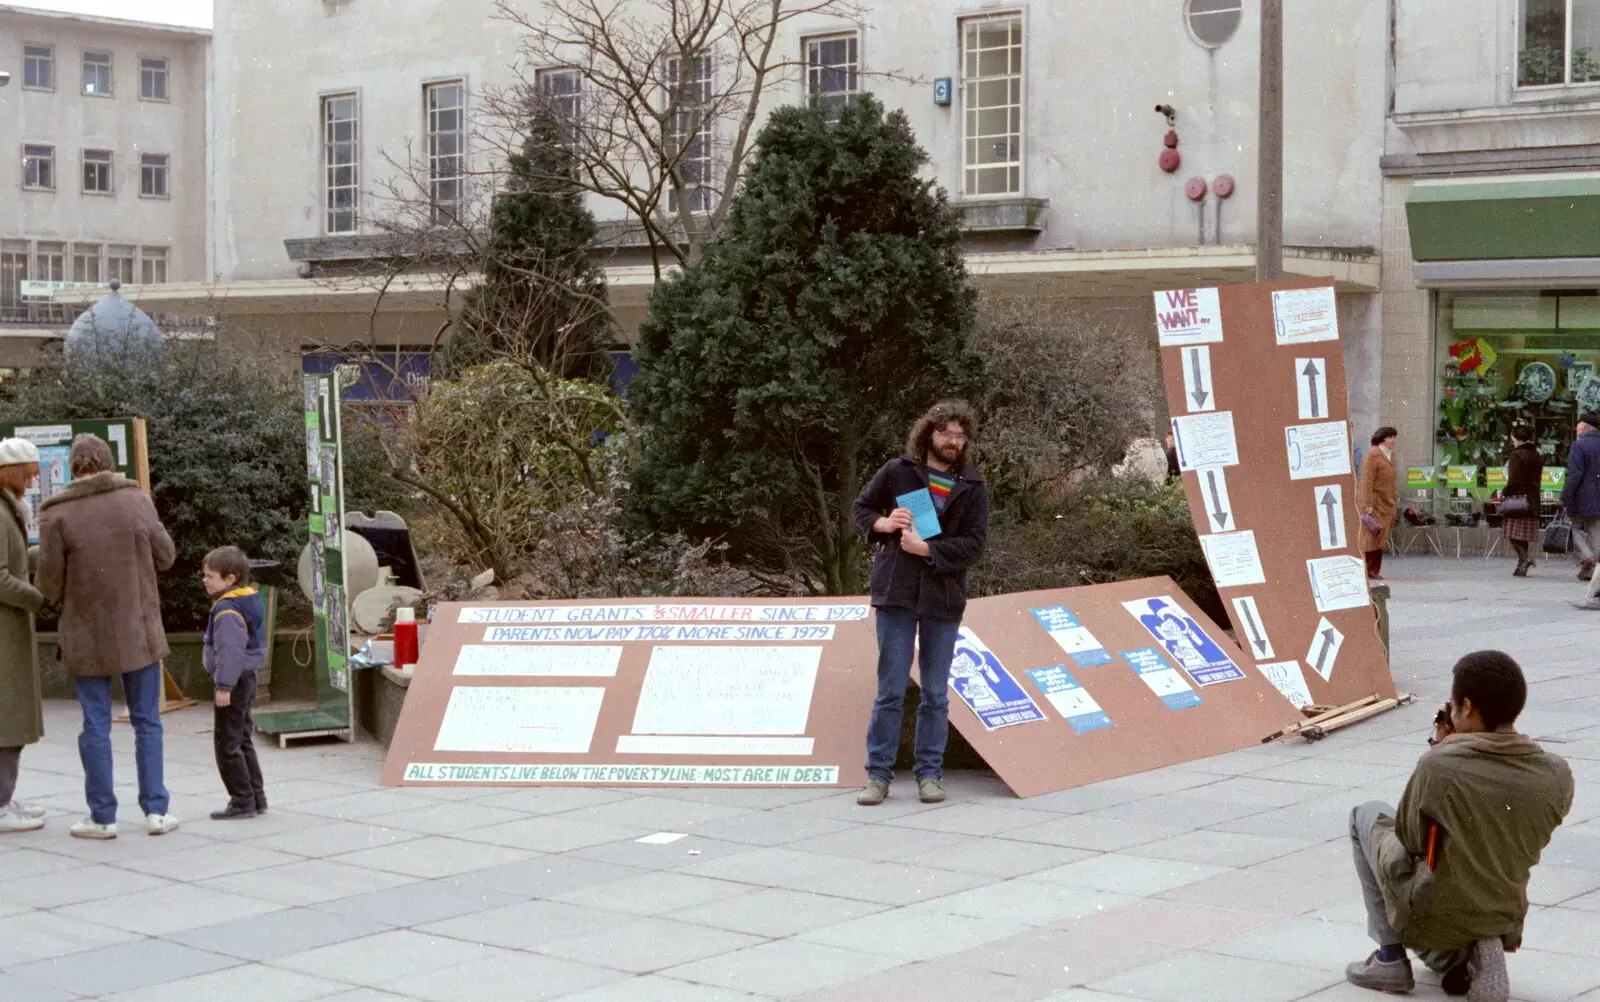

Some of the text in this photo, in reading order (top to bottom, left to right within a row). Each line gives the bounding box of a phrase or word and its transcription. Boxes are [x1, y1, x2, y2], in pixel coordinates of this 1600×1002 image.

[1166, 289, 1198, 308] WE
[1274, 293, 1286, 337] 6
[1287, 428, 1301, 471] 5
[471, 607, 560, 623] STUDENT
[567, 607, 646, 621] GRANTS
[666, 606, 753, 621] SMALLER
[759, 606, 818, 621] SINCE
[826, 605, 867, 621] 1979
[492, 627, 561, 641] PARENTS
[564, 626, 605, 641] NOW
[605, 626, 633, 640] PAY
[677, 626, 733, 640] MORE
[733, 625, 784, 640] SINCE
[791, 625, 831, 640] 1979
[408, 765, 434, 779] ALL
[438, 765, 509, 780] STUDENTS
[509, 766, 539, 780] LIVE
[540, 766, 581, 781] BELOW
[583, 766, 607, 781] THE
[703, 767, 742, 782] MOST
[742, 767, 774, 782] ARE
[776, 768, 792, 782] IN
[793, 767, 836, 783] DEBT
